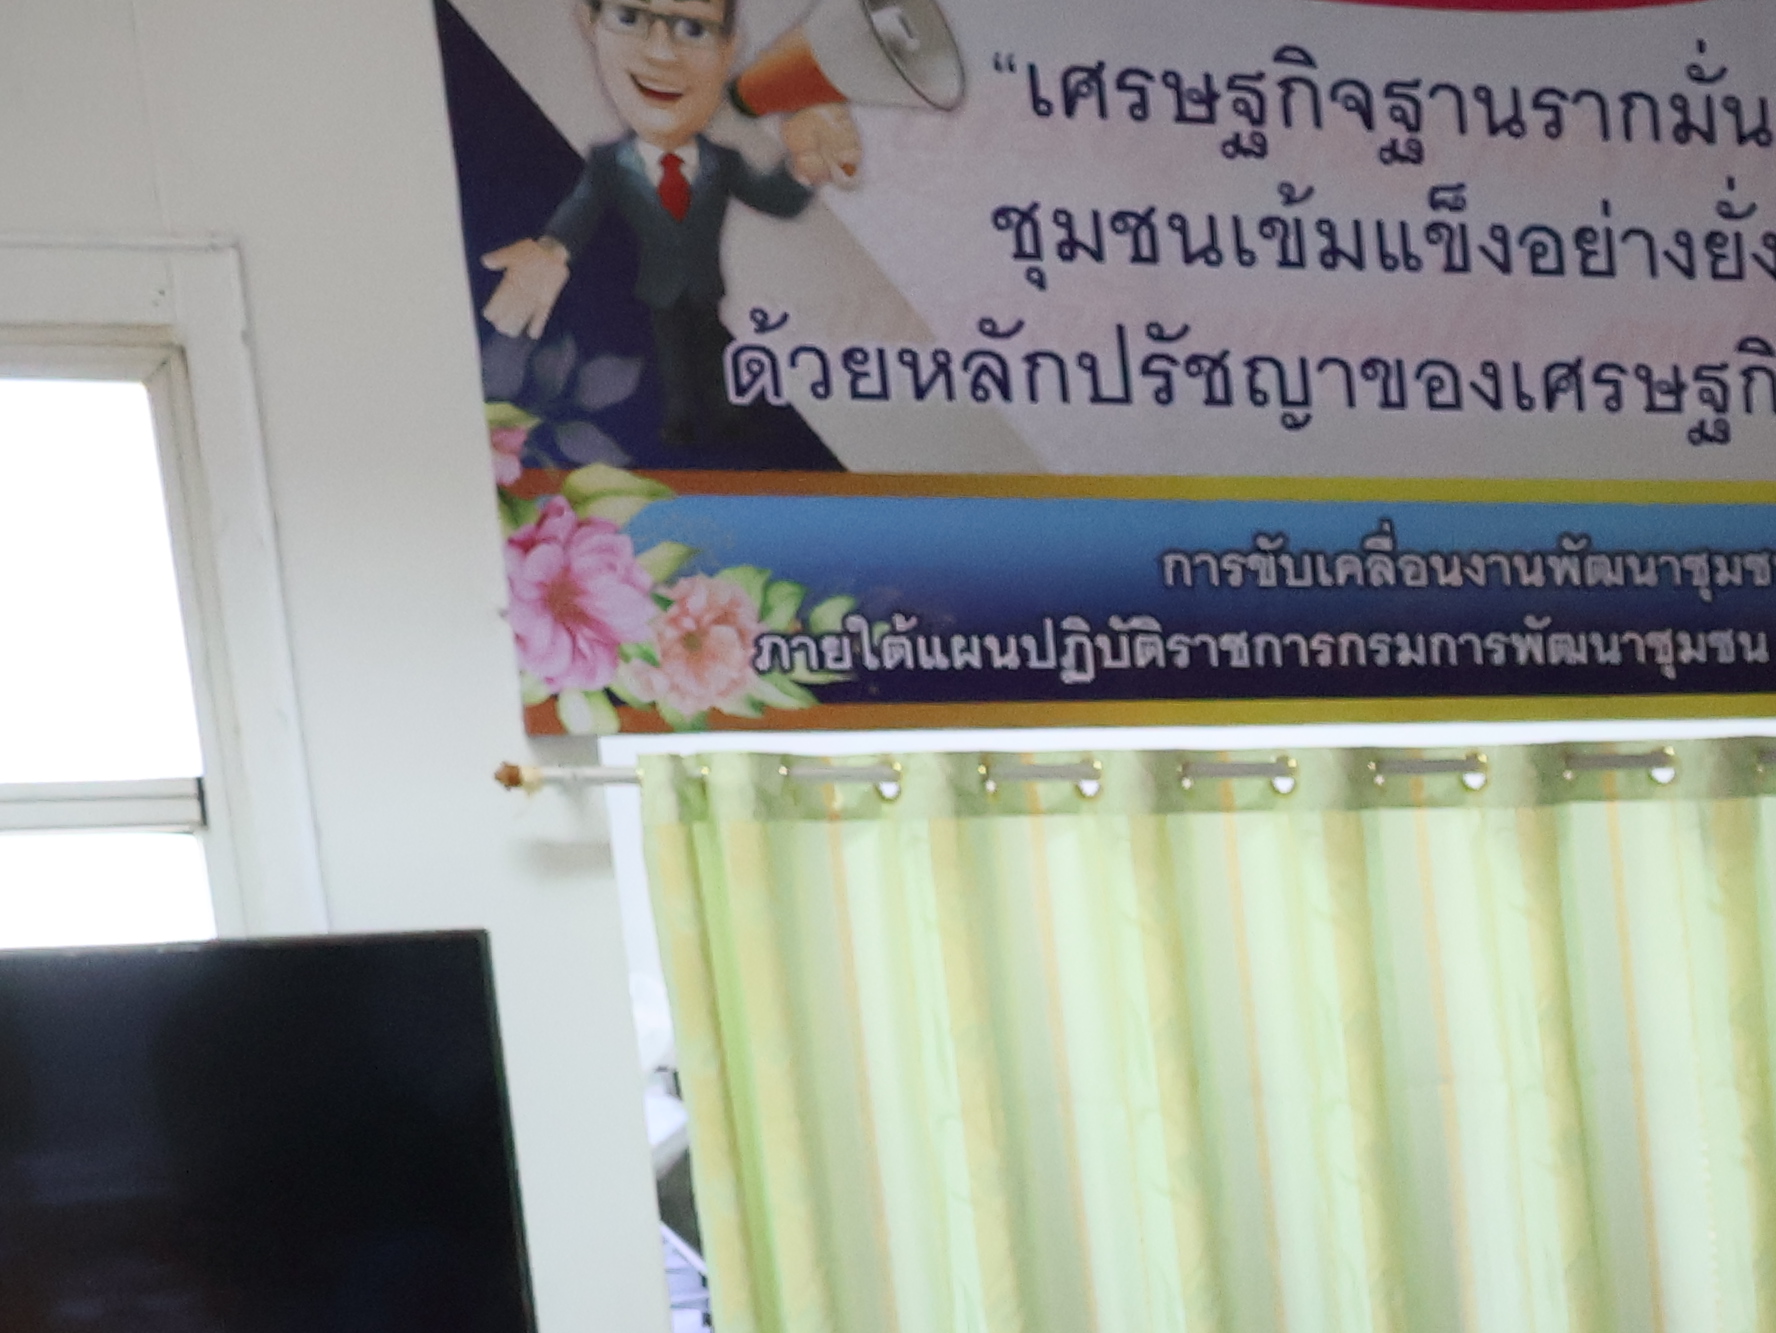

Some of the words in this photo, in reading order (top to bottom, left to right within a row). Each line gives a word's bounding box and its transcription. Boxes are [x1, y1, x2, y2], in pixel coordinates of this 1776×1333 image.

[750, 613, 1770, 686] ภายใต้แผนปฏิบัติราชการกรมการพัฒนาชุมชน
